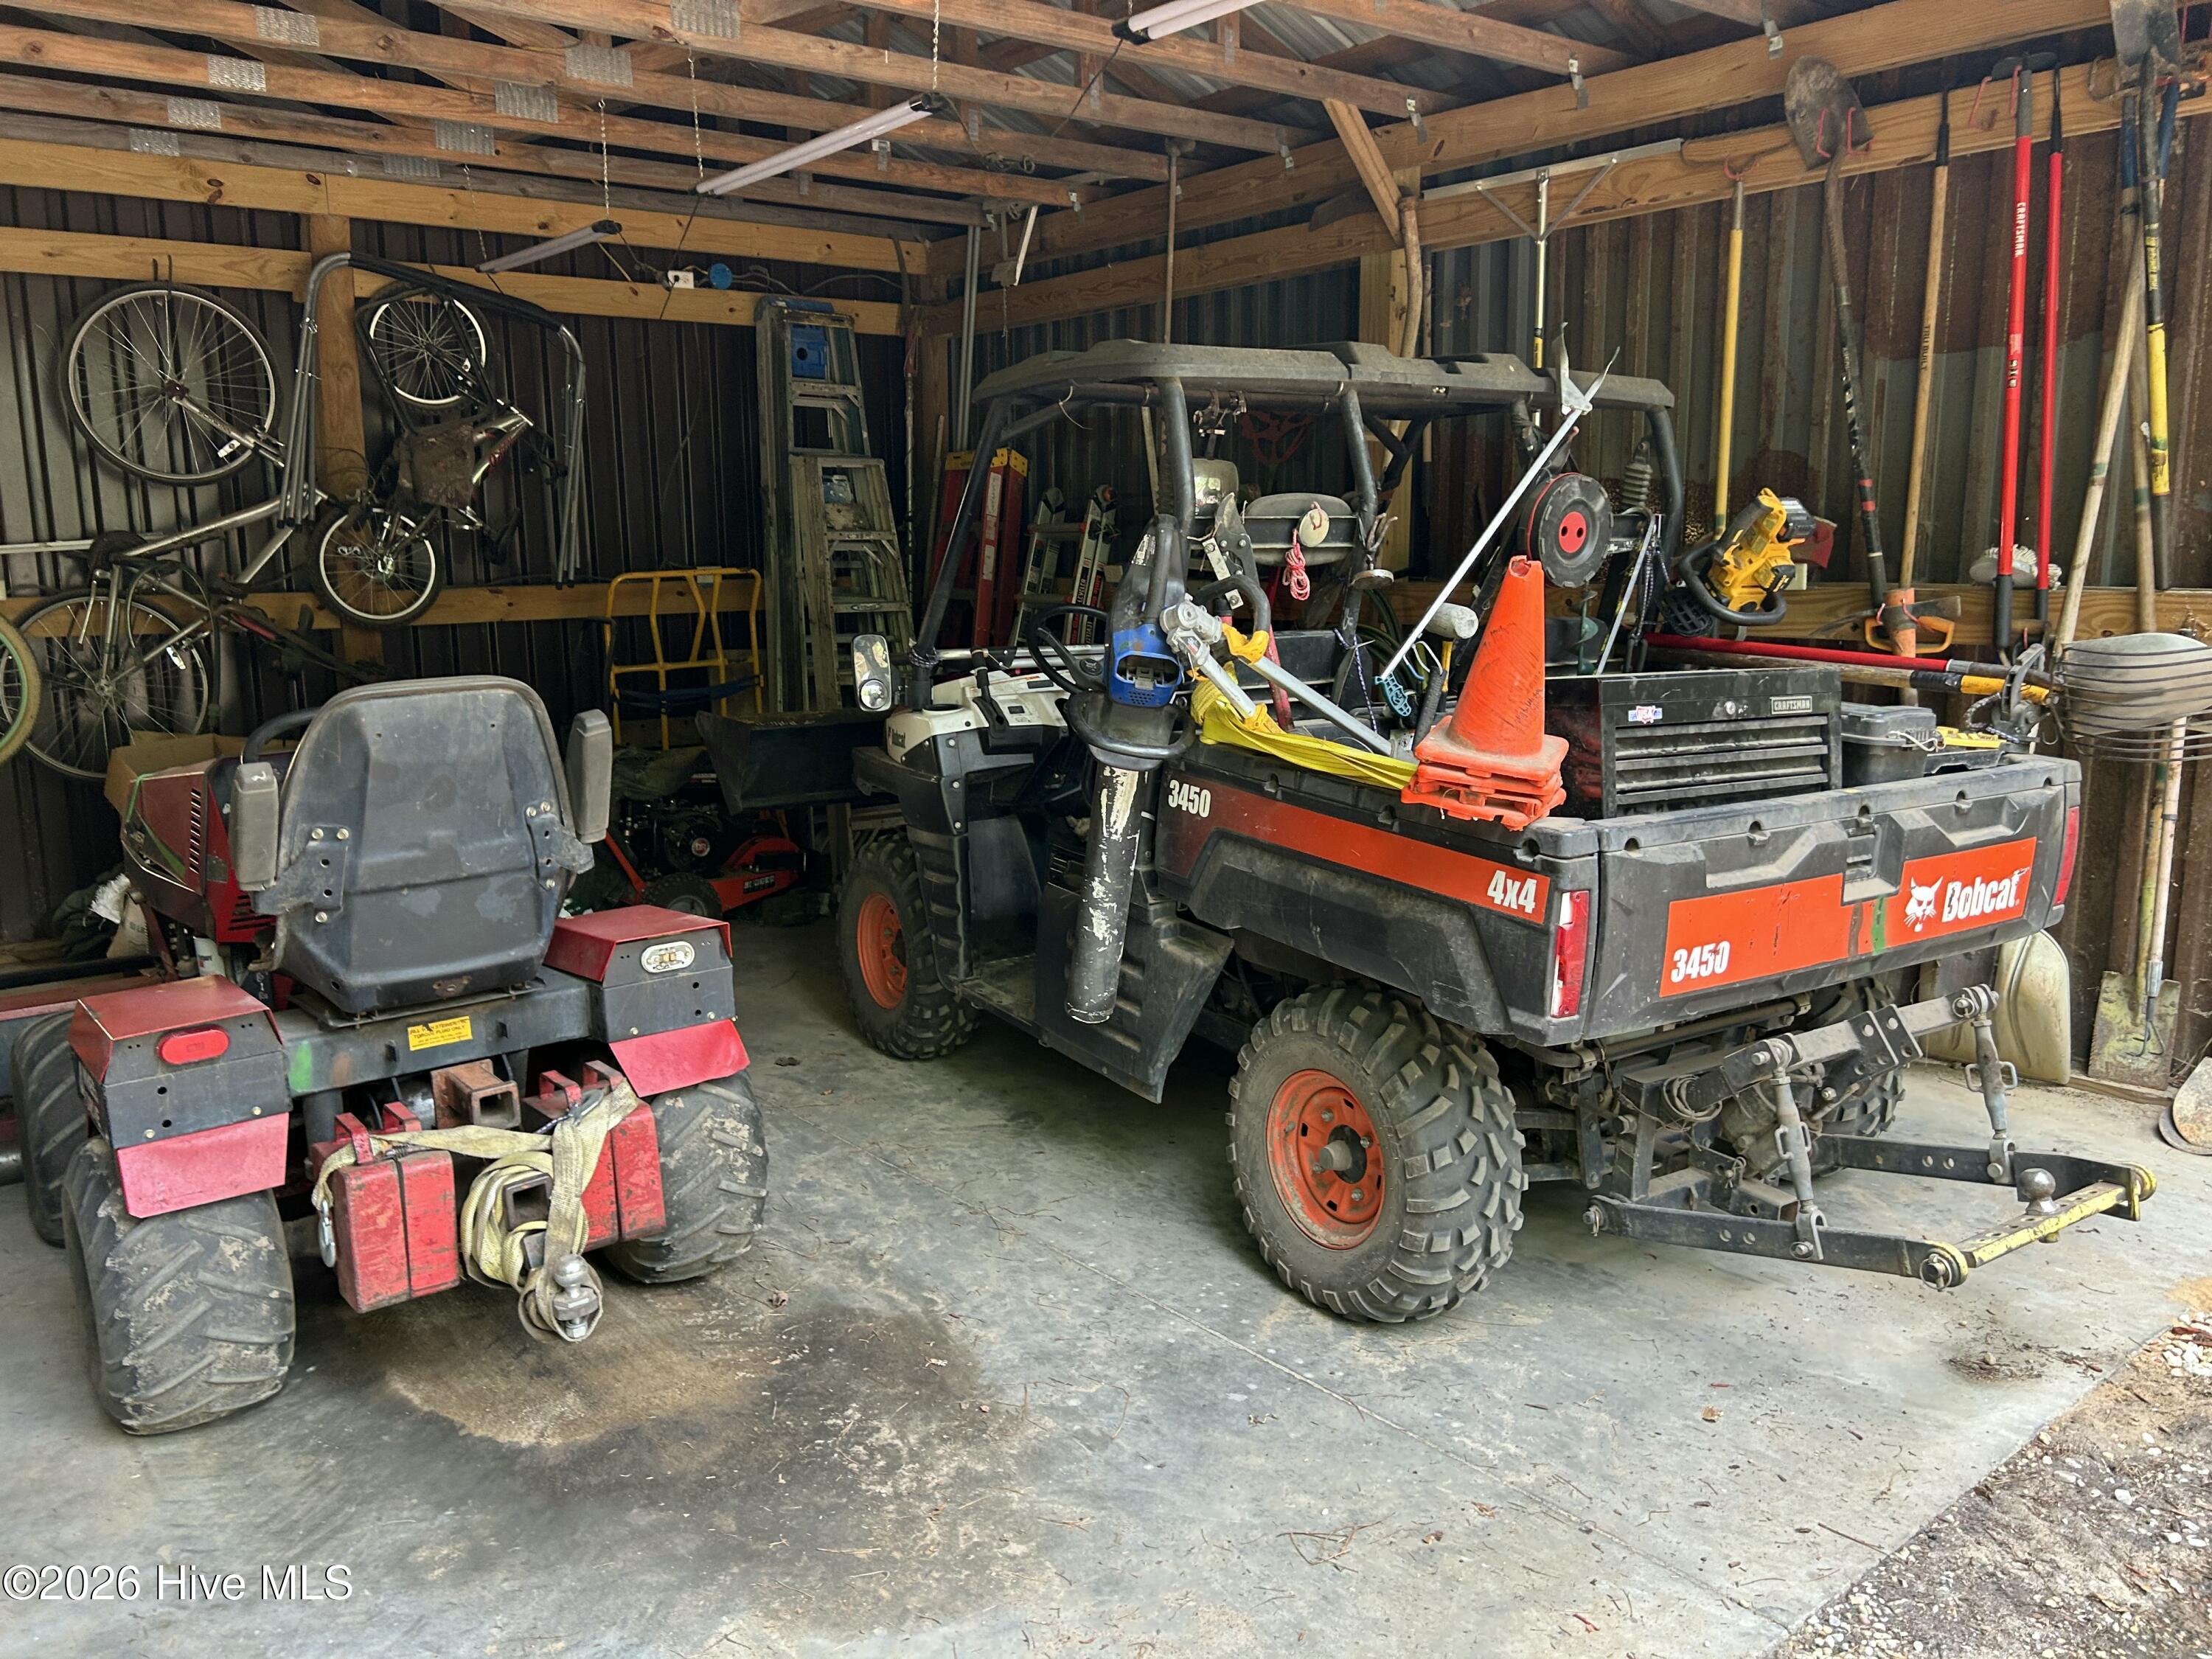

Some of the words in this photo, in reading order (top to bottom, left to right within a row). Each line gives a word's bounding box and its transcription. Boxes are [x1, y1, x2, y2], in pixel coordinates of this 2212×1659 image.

[2015, 201, 2026, 257] CRAFTSMAN
[1921, 346, 1930, 369] BUILT
[1774, 699, 1810, 711] CRAFTSMAN
[1168, 779, 1211, 818] 3450
[1487, 870, 1537, 914] 4x4
[1941, 868, 2028, 922] Bobcat
[1671, 941, 1731, 983] 3450
